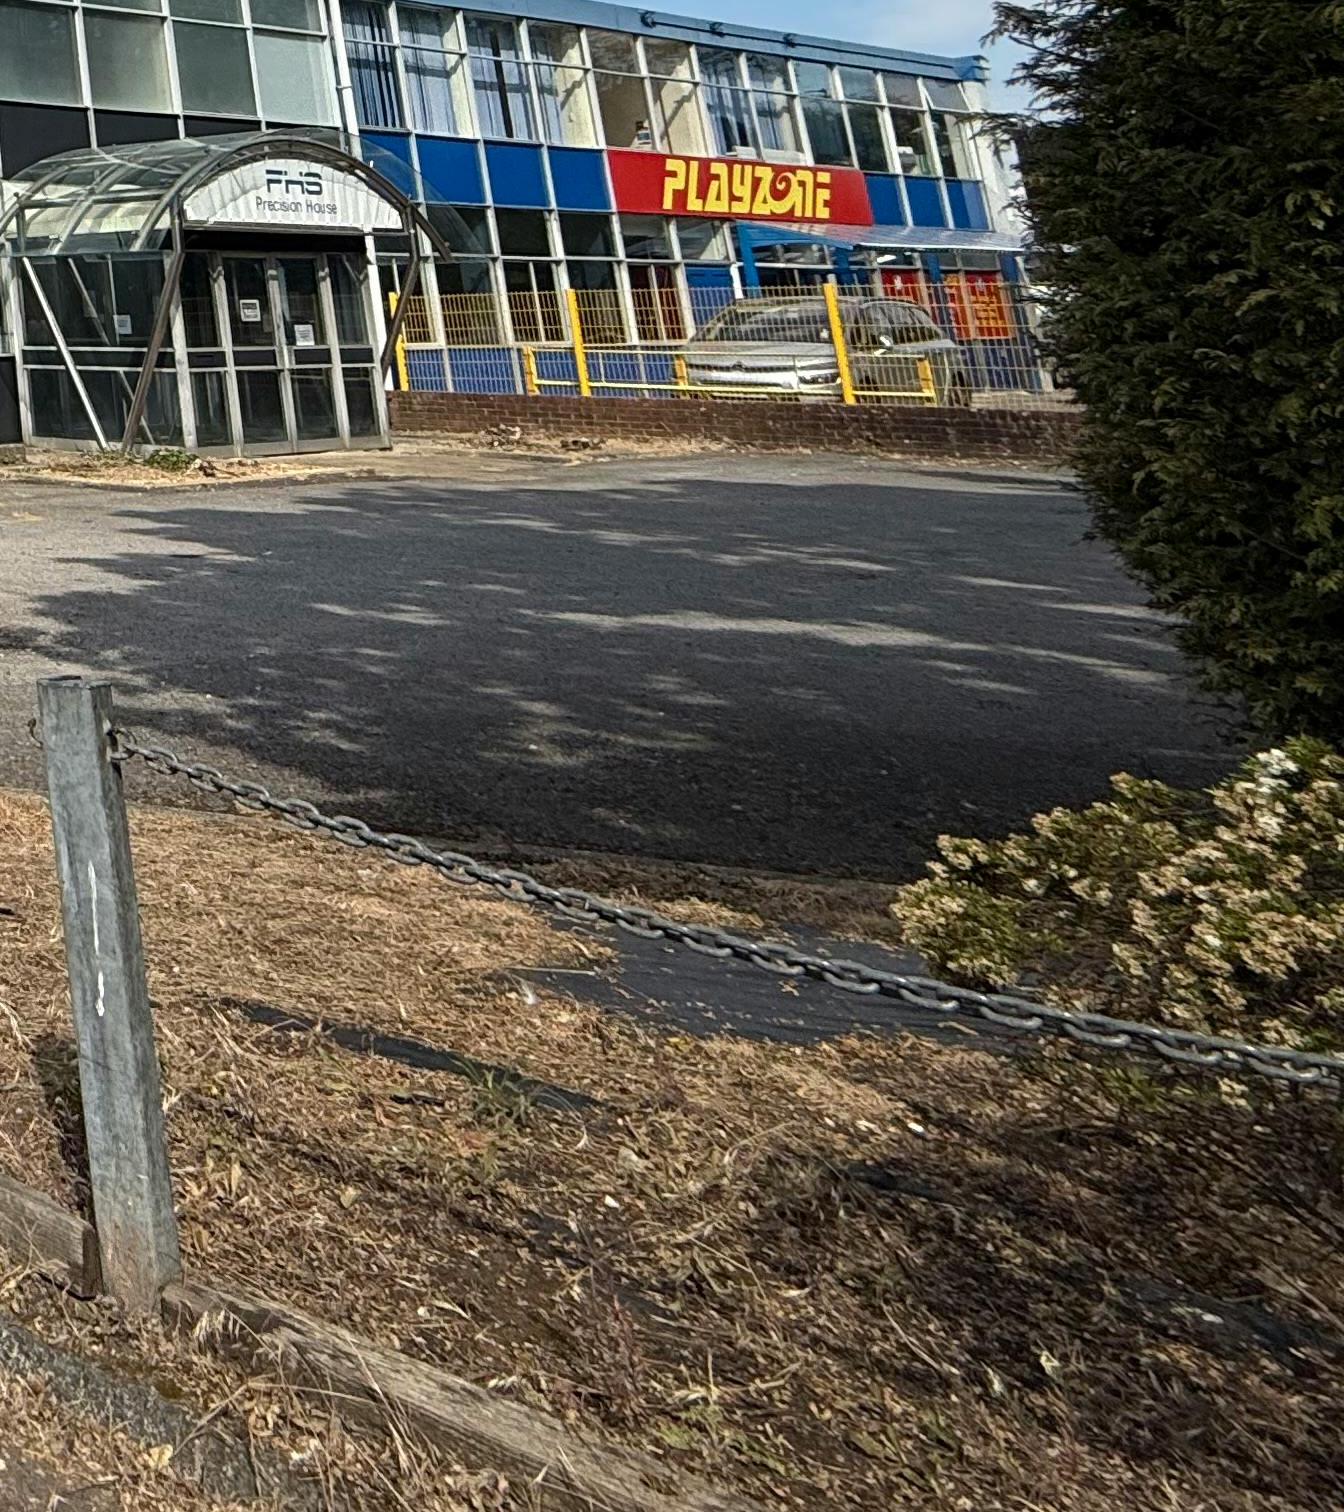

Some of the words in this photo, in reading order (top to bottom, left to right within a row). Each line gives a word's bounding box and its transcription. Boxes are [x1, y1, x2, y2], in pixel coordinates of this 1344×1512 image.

[255, 196, 302, 213] Precision
[305, 199, 337, 214] House
[662, 158, 831, 219] PLAYZONE
